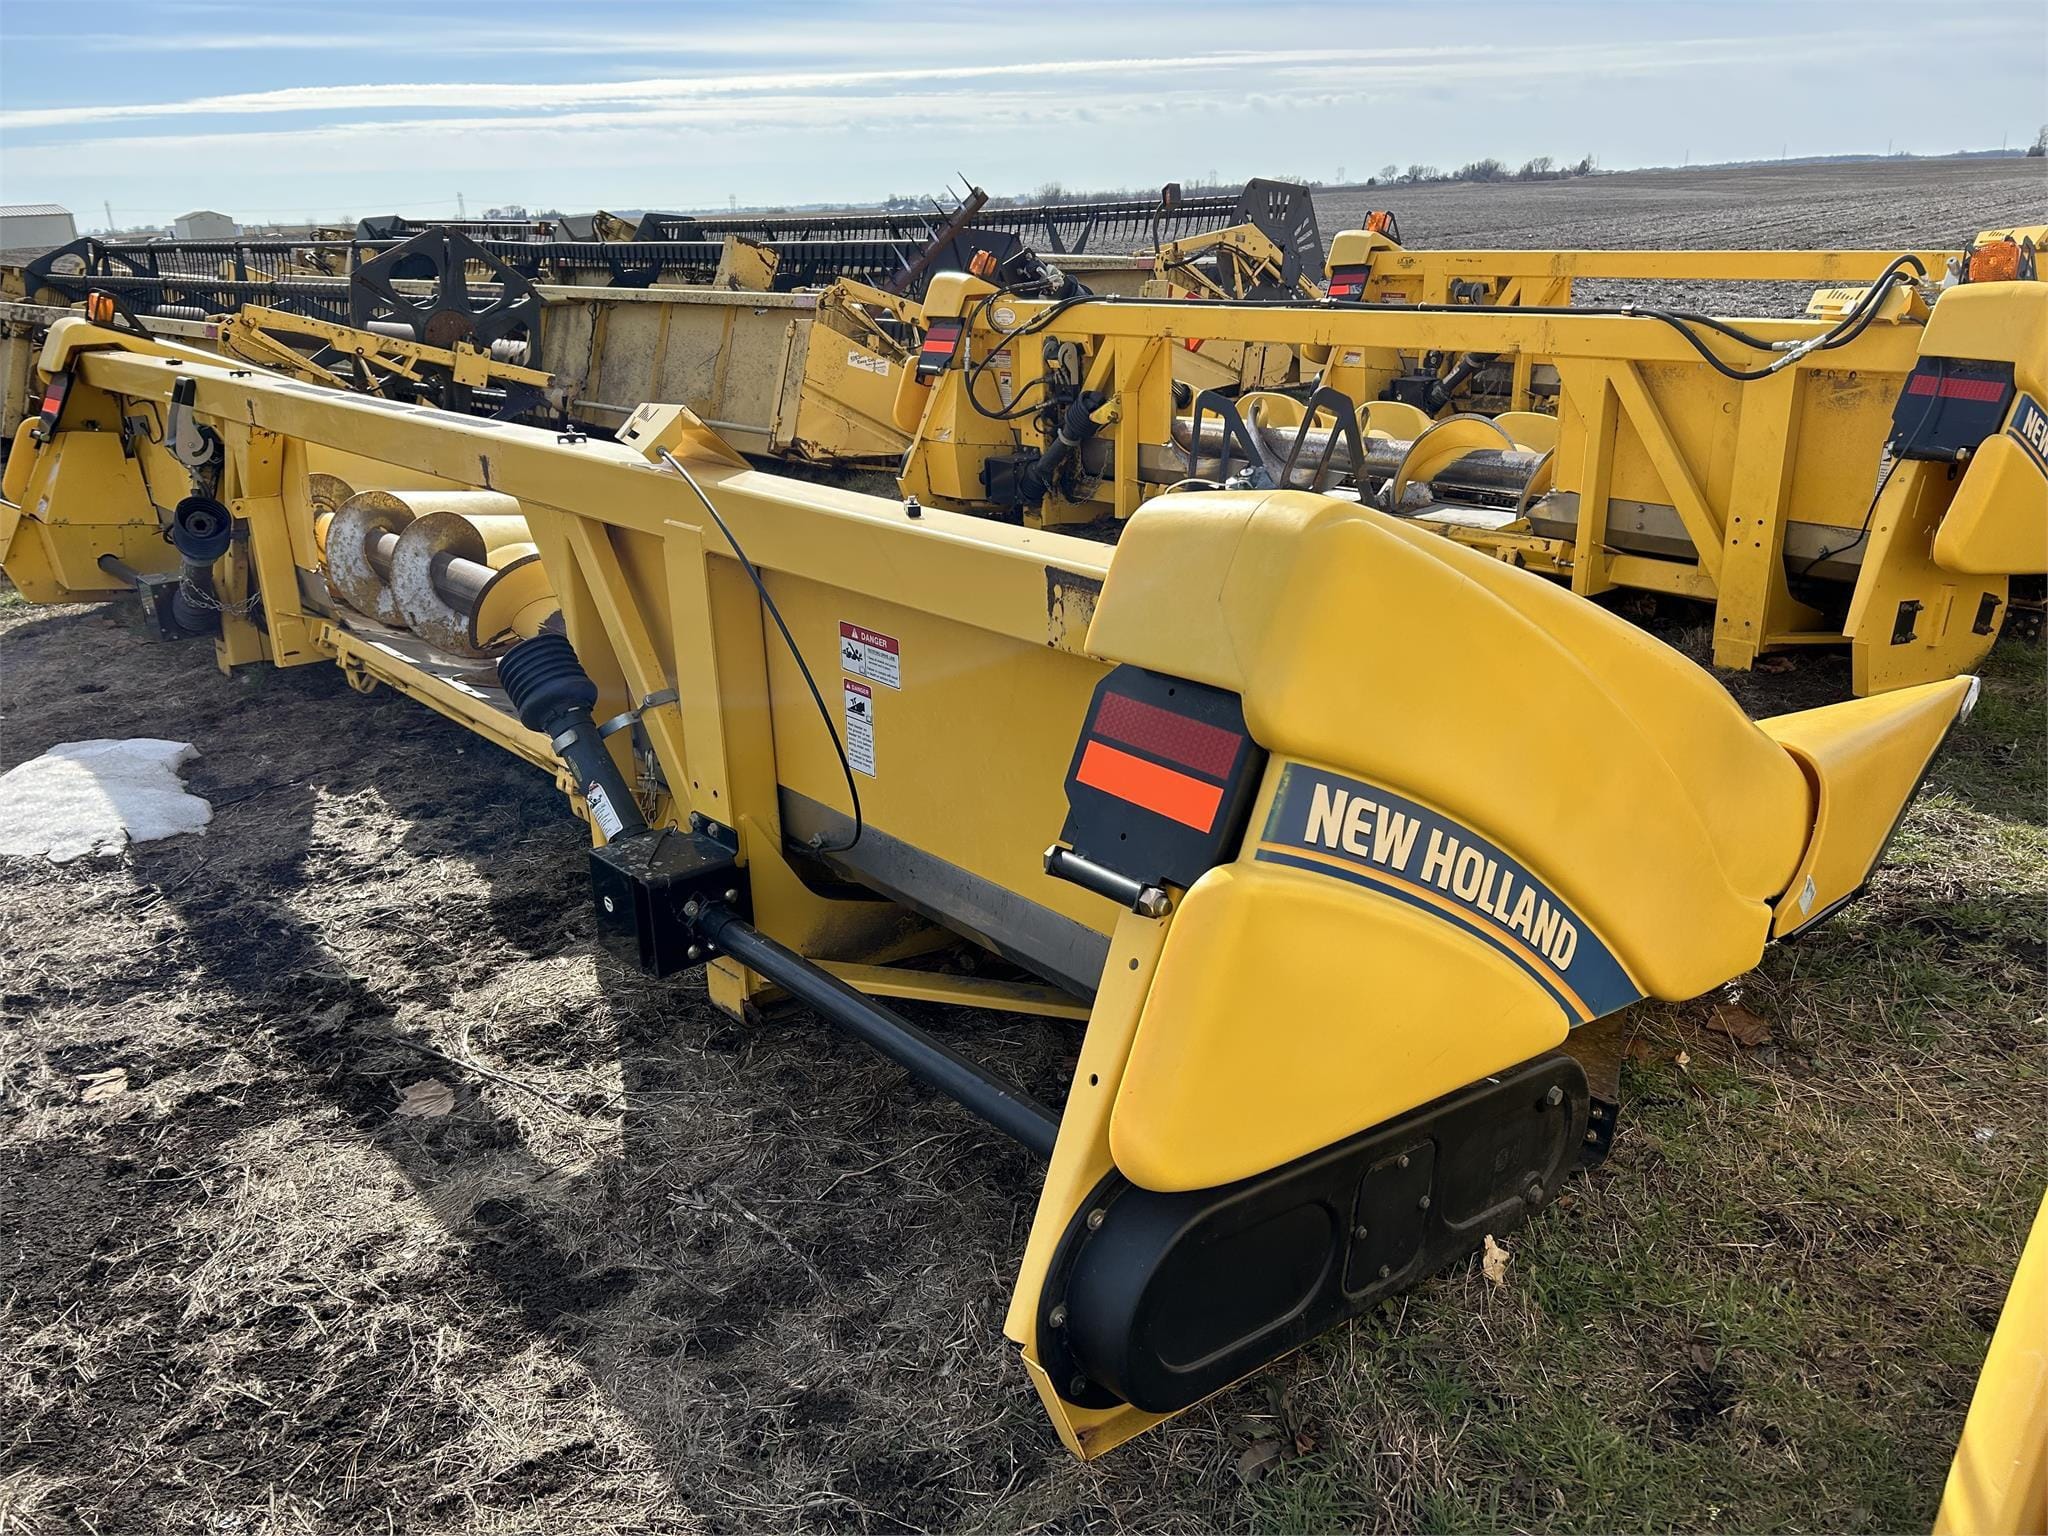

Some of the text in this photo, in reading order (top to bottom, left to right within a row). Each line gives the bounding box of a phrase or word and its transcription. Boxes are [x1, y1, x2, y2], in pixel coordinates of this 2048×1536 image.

[860, 632, 888, 649] DANGER
[1303, 782, 1578, 972] NEW HOLLAND
